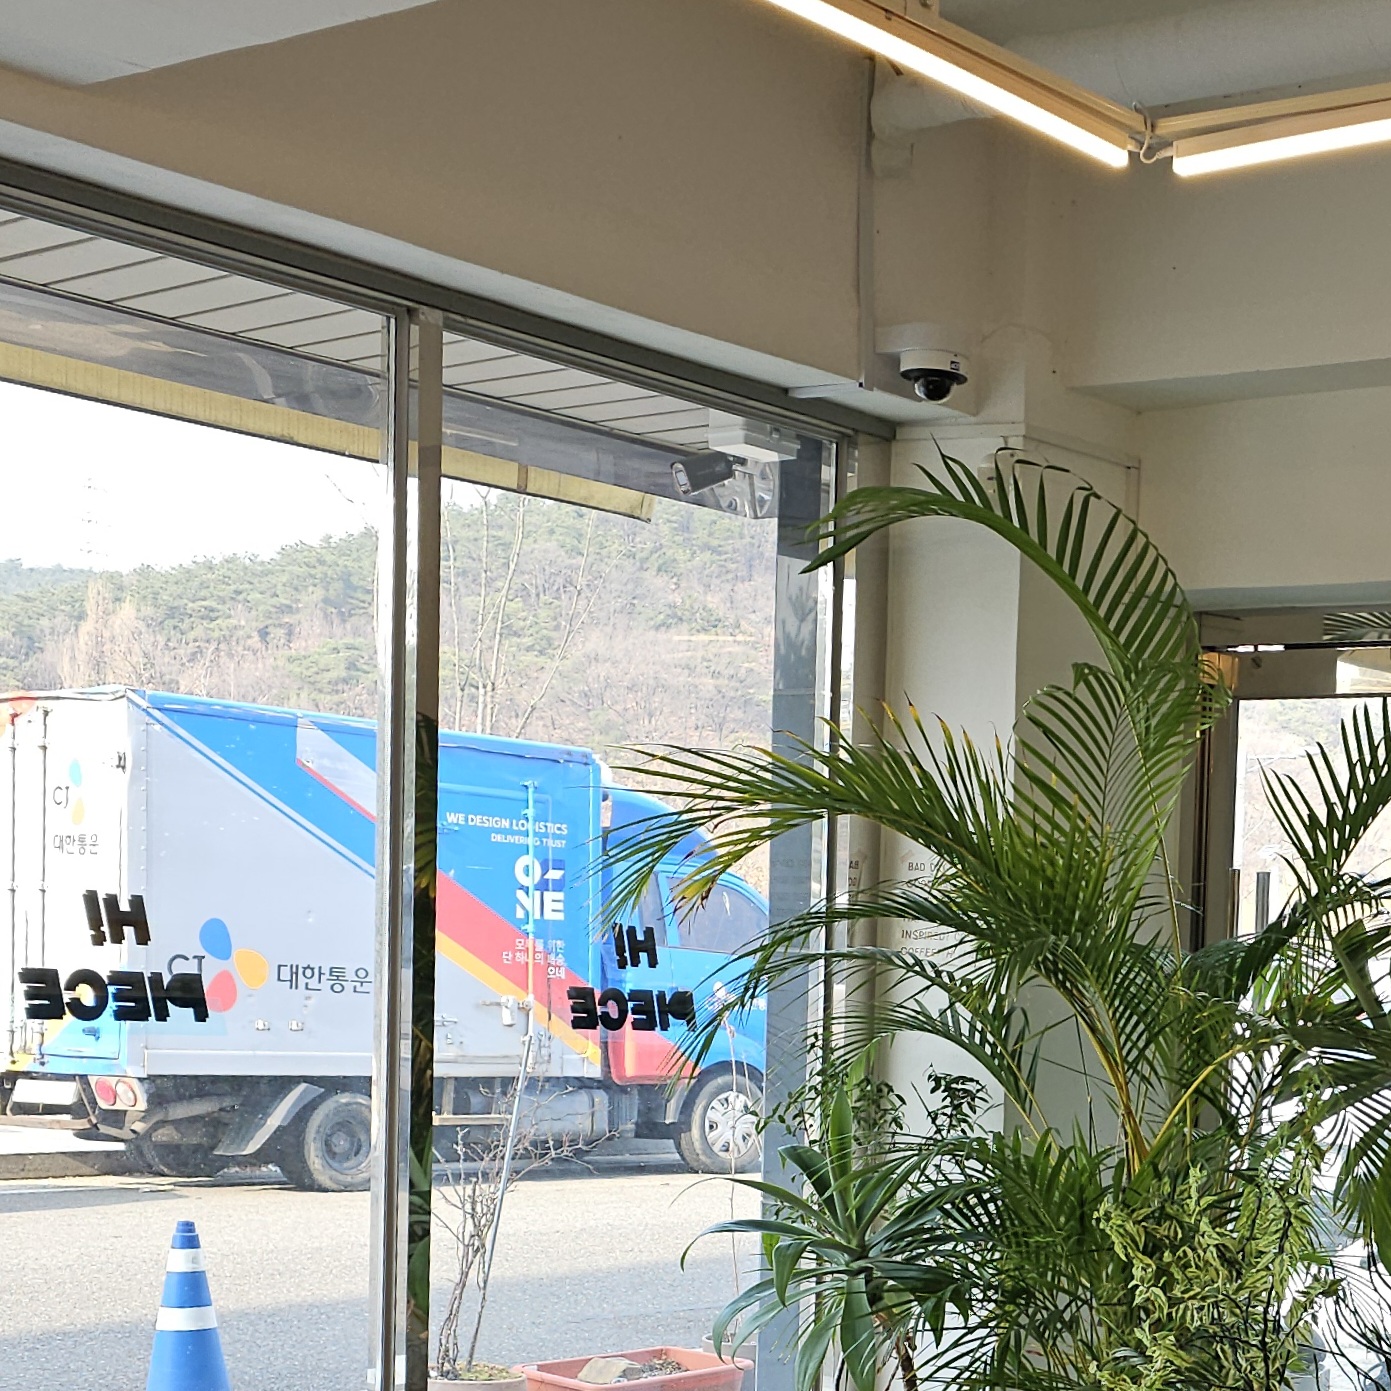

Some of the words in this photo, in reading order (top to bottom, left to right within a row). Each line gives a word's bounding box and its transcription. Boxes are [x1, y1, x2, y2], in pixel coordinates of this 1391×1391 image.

[53, 786, 69, 808] CJ
[446, 811, 465, 824] WE
[468, 814, 510, 828] DESIGN
[512, 819, 568, 834] LOISTICS
[53, 833, 99, 855] 대한통운
[491, 833, 540, 846] DELIVERIG
[277, 963, 373, 994] 대한통운
